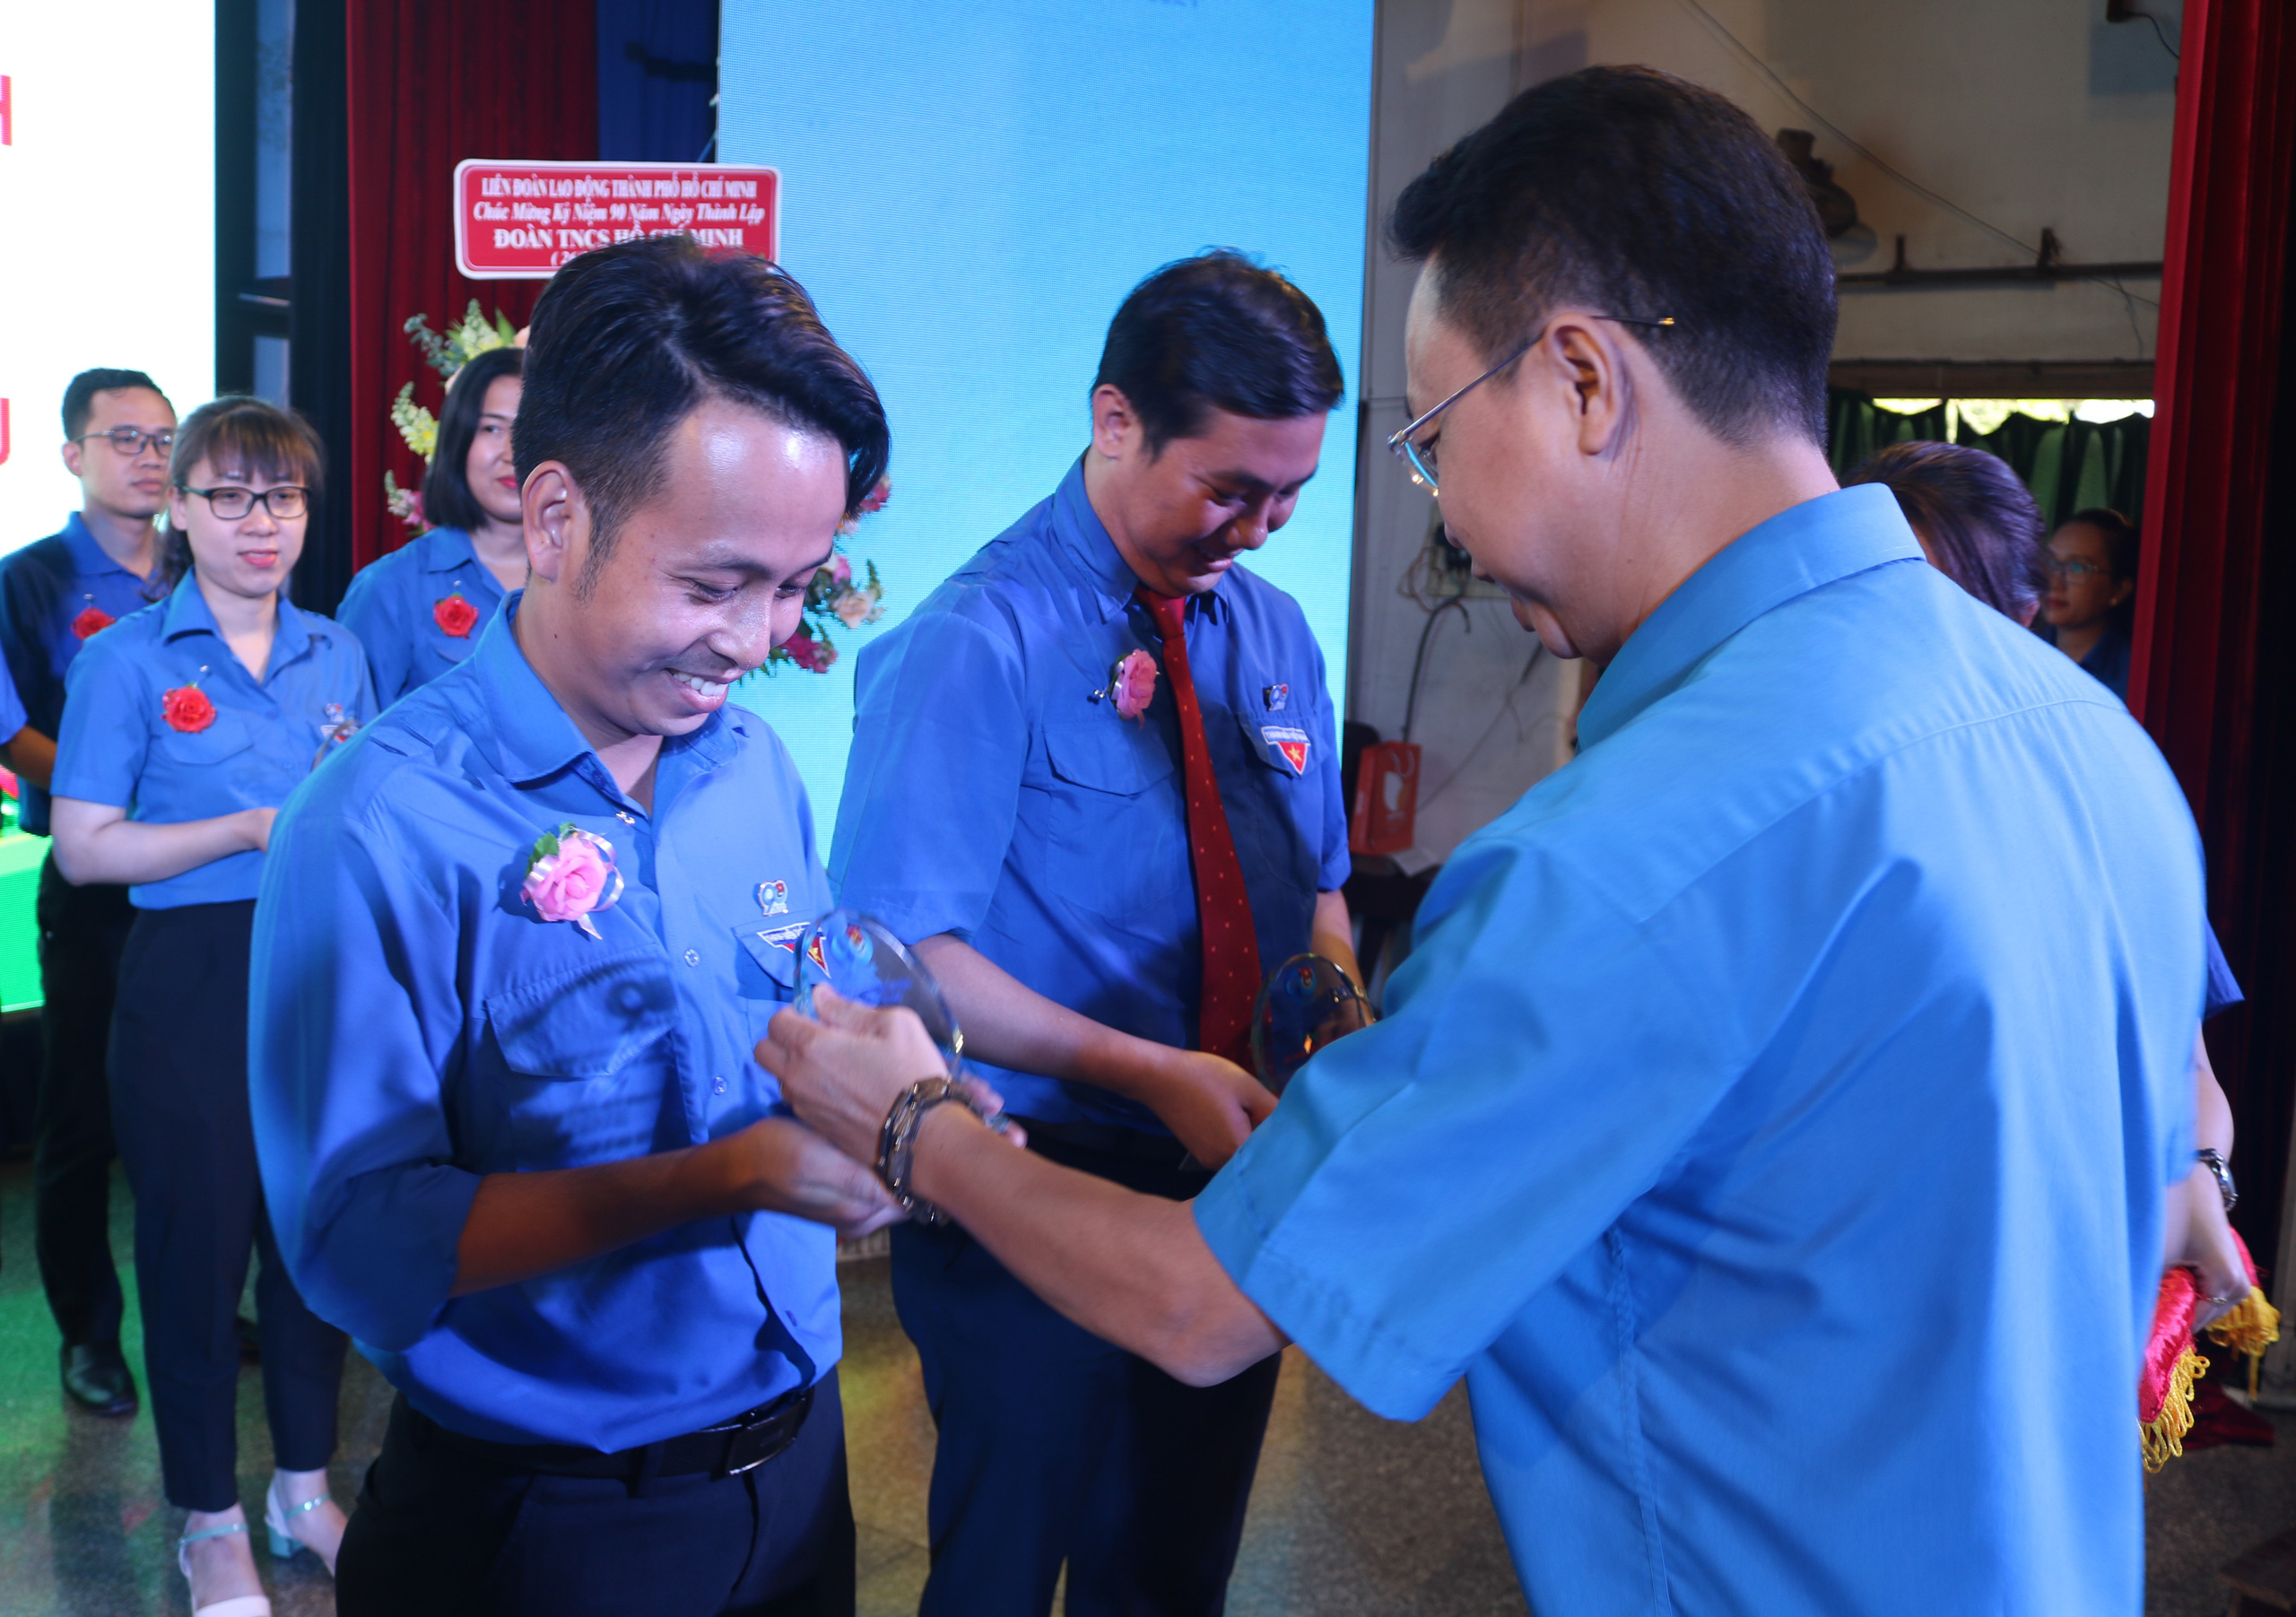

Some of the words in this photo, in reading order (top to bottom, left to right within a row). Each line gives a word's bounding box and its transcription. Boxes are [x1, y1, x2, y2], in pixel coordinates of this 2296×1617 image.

[482, 173, 512, 197] LIÊN
[549, 178, 574, 197] LAO
[611, 174, 654, 198] THÀNH
[700, 175, 725, 198] CHÍ
[725, 180, 758, 198] MINH
[473, 201, 510, 221] Chúc
[609, 203, 628, 221] 90
[628, 203, 661, 222] Năm
[661, 203, 695, 226] Ngày
[696, 203, 738, 222] Thành
[738, 203, 766, 226] Lập
[493, 223, 553, 249] ĐOÀN
[556, 229, 611, 249] TNCS
